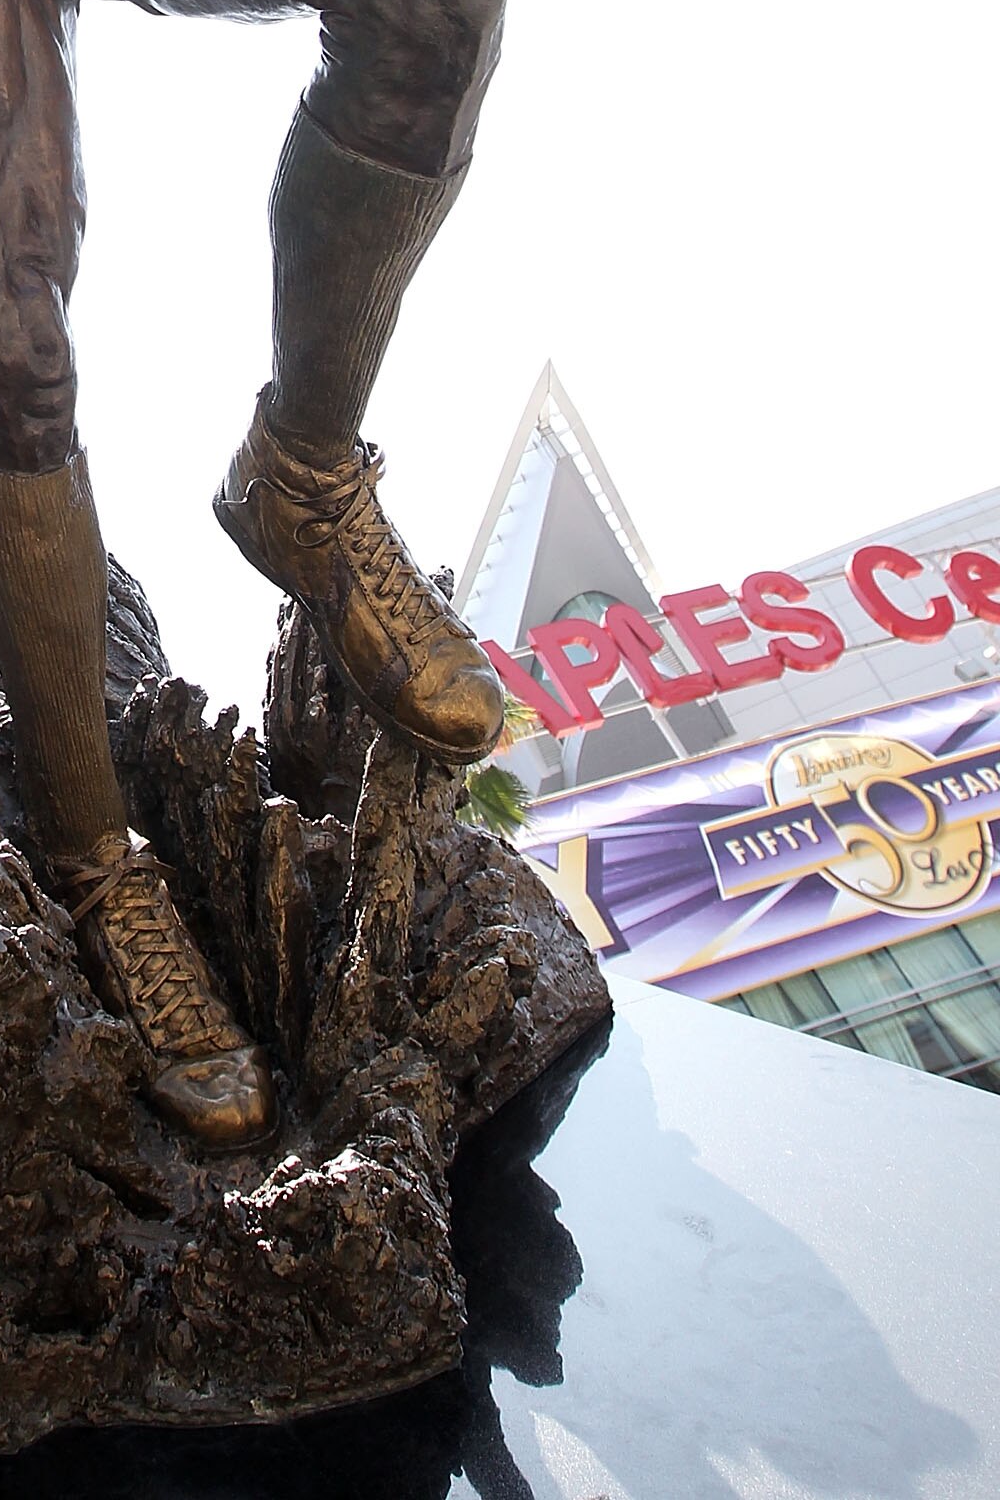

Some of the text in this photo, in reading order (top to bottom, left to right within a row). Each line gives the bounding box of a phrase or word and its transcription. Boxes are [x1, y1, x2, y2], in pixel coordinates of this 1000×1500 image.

[724, 762, 1000, 866] FIFTY YEAR
[809, 774, 938, 897] 50
[911, 846, 968, 889] Los
